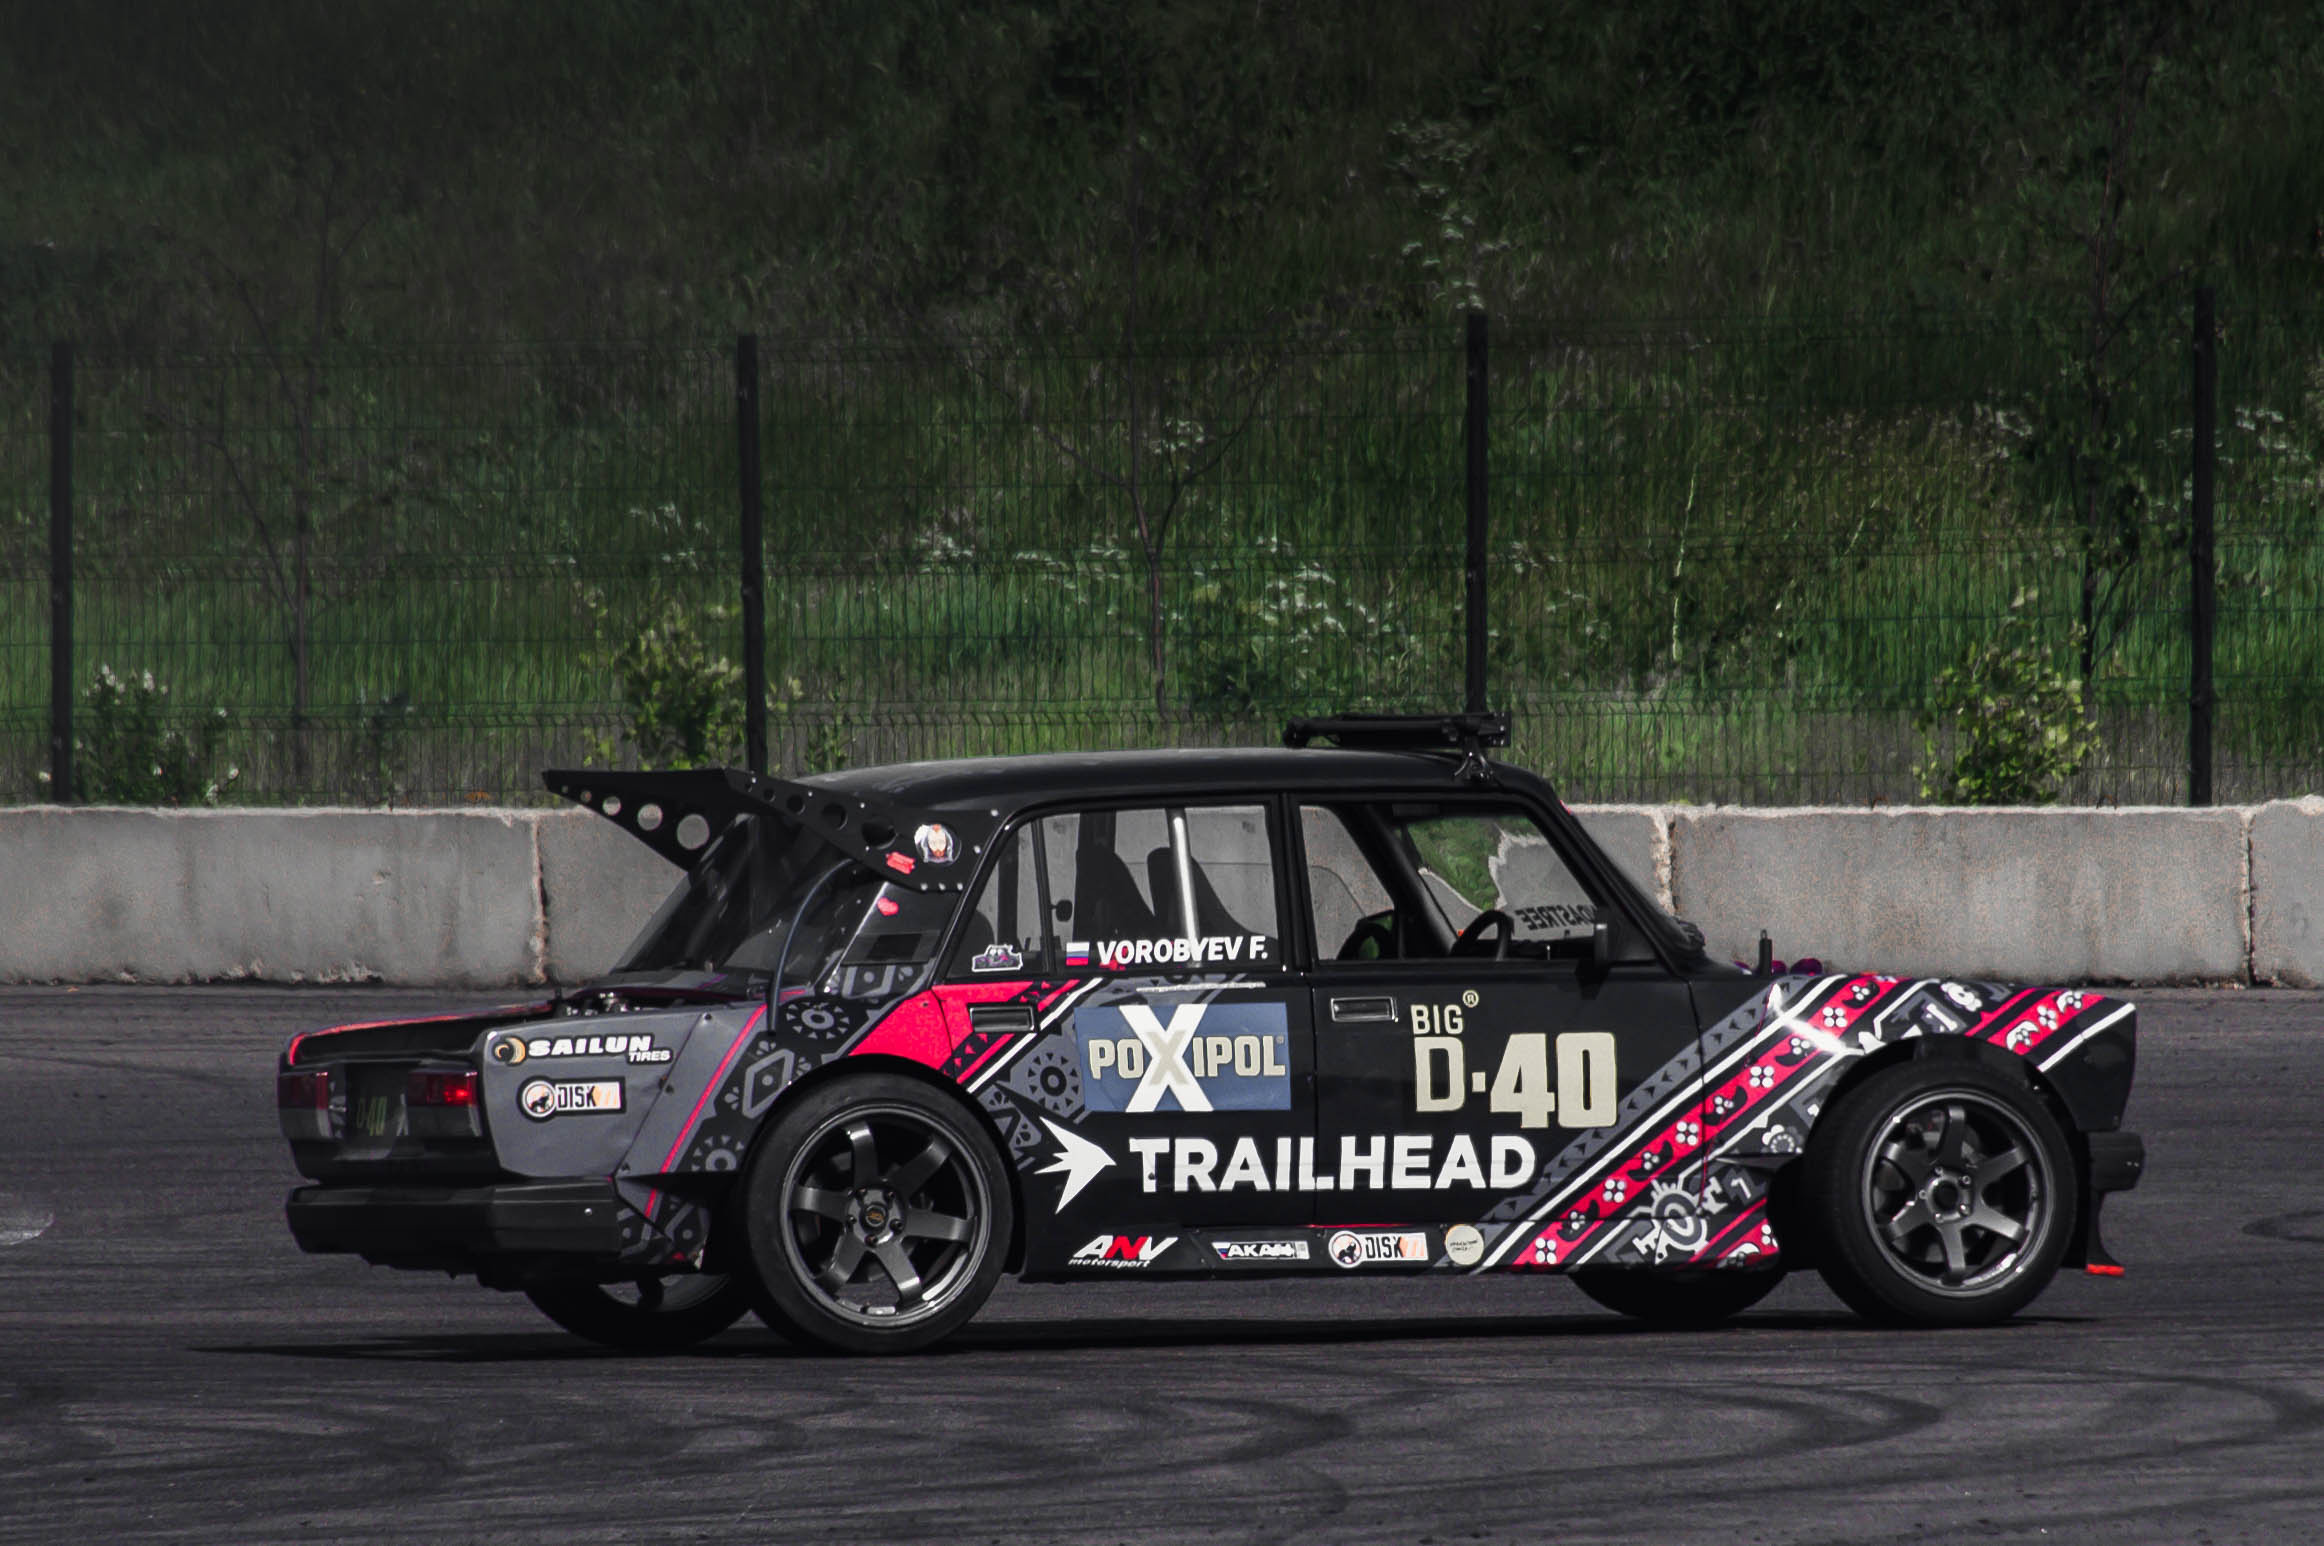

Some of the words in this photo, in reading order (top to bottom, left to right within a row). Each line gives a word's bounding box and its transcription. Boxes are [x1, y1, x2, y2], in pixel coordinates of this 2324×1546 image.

[1096, 936, 1240, 965] VOROBYEV
[1246, 935, 1266, 960] F.
[1411, 1004, 1463, 1035] BIG
[528, 1036, 652, 1057] SAILUN
[628, 1051, 671, 1063] TIRES
[1413, 1032, 1617, 1129] D-40
[1128, 1135, 1537, 1193] TRAILHEAD
[1068, 1258, 1151, 1269] motorsport
